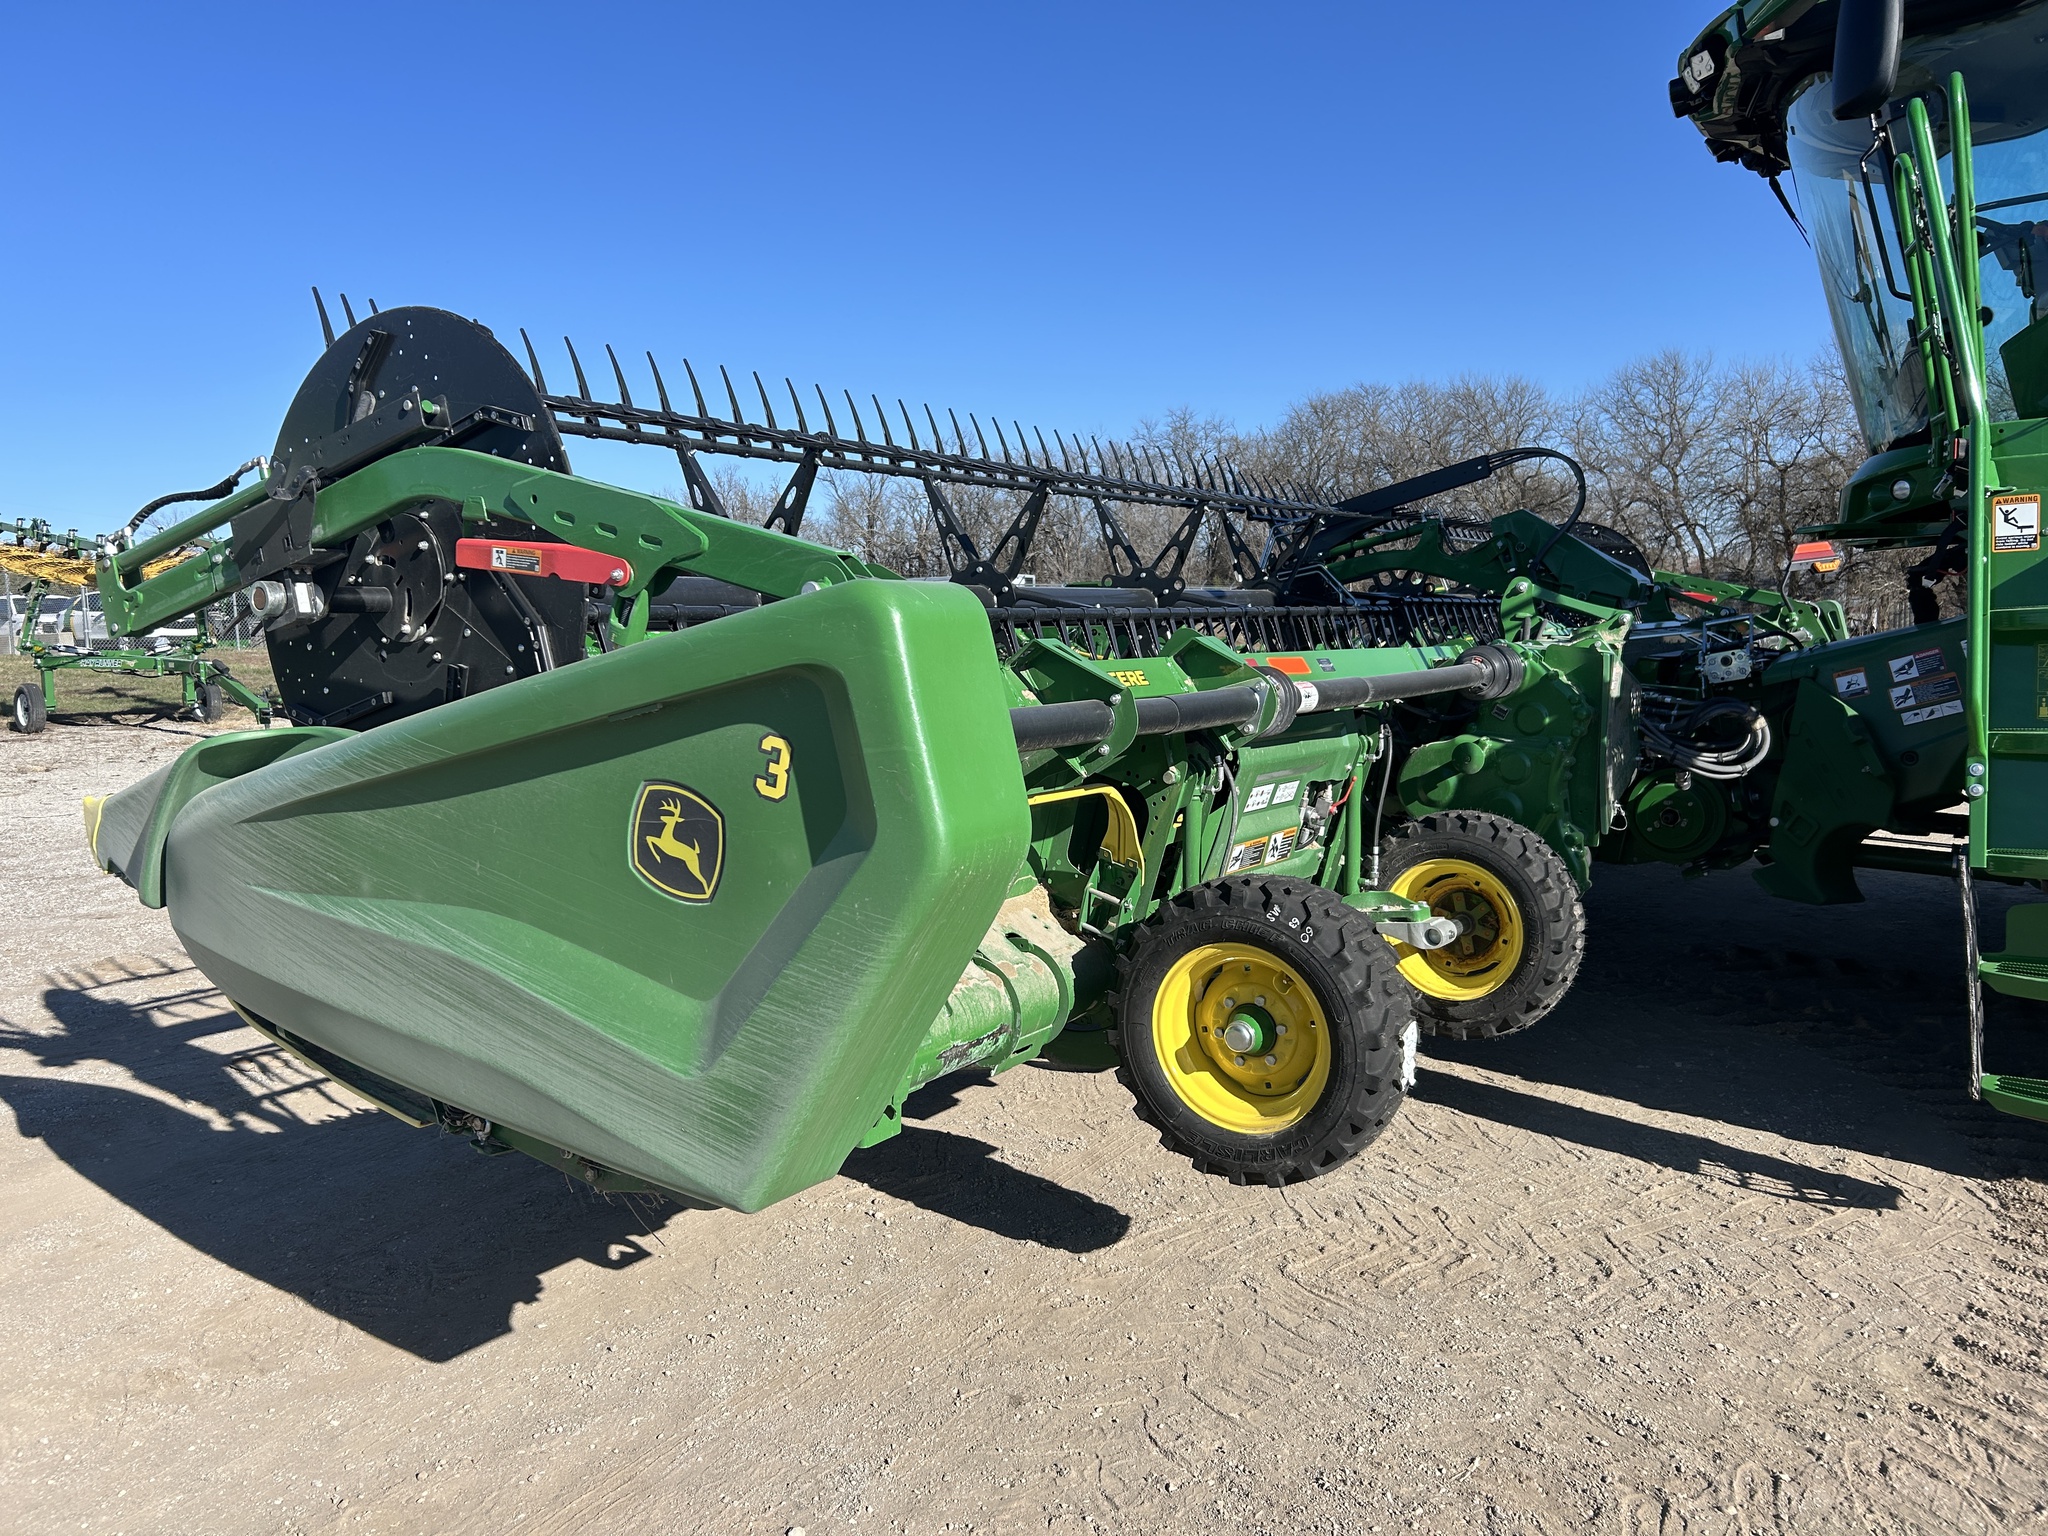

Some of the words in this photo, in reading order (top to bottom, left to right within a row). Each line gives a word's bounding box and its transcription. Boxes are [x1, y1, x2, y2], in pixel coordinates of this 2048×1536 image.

[2003, 495, 2038, 504] WARNING
[753, 732, 794, 803] 3
[1220, 917, 1287, 944] CHIEF
[1184, 1129, 1311, 1164] CARLISLE
